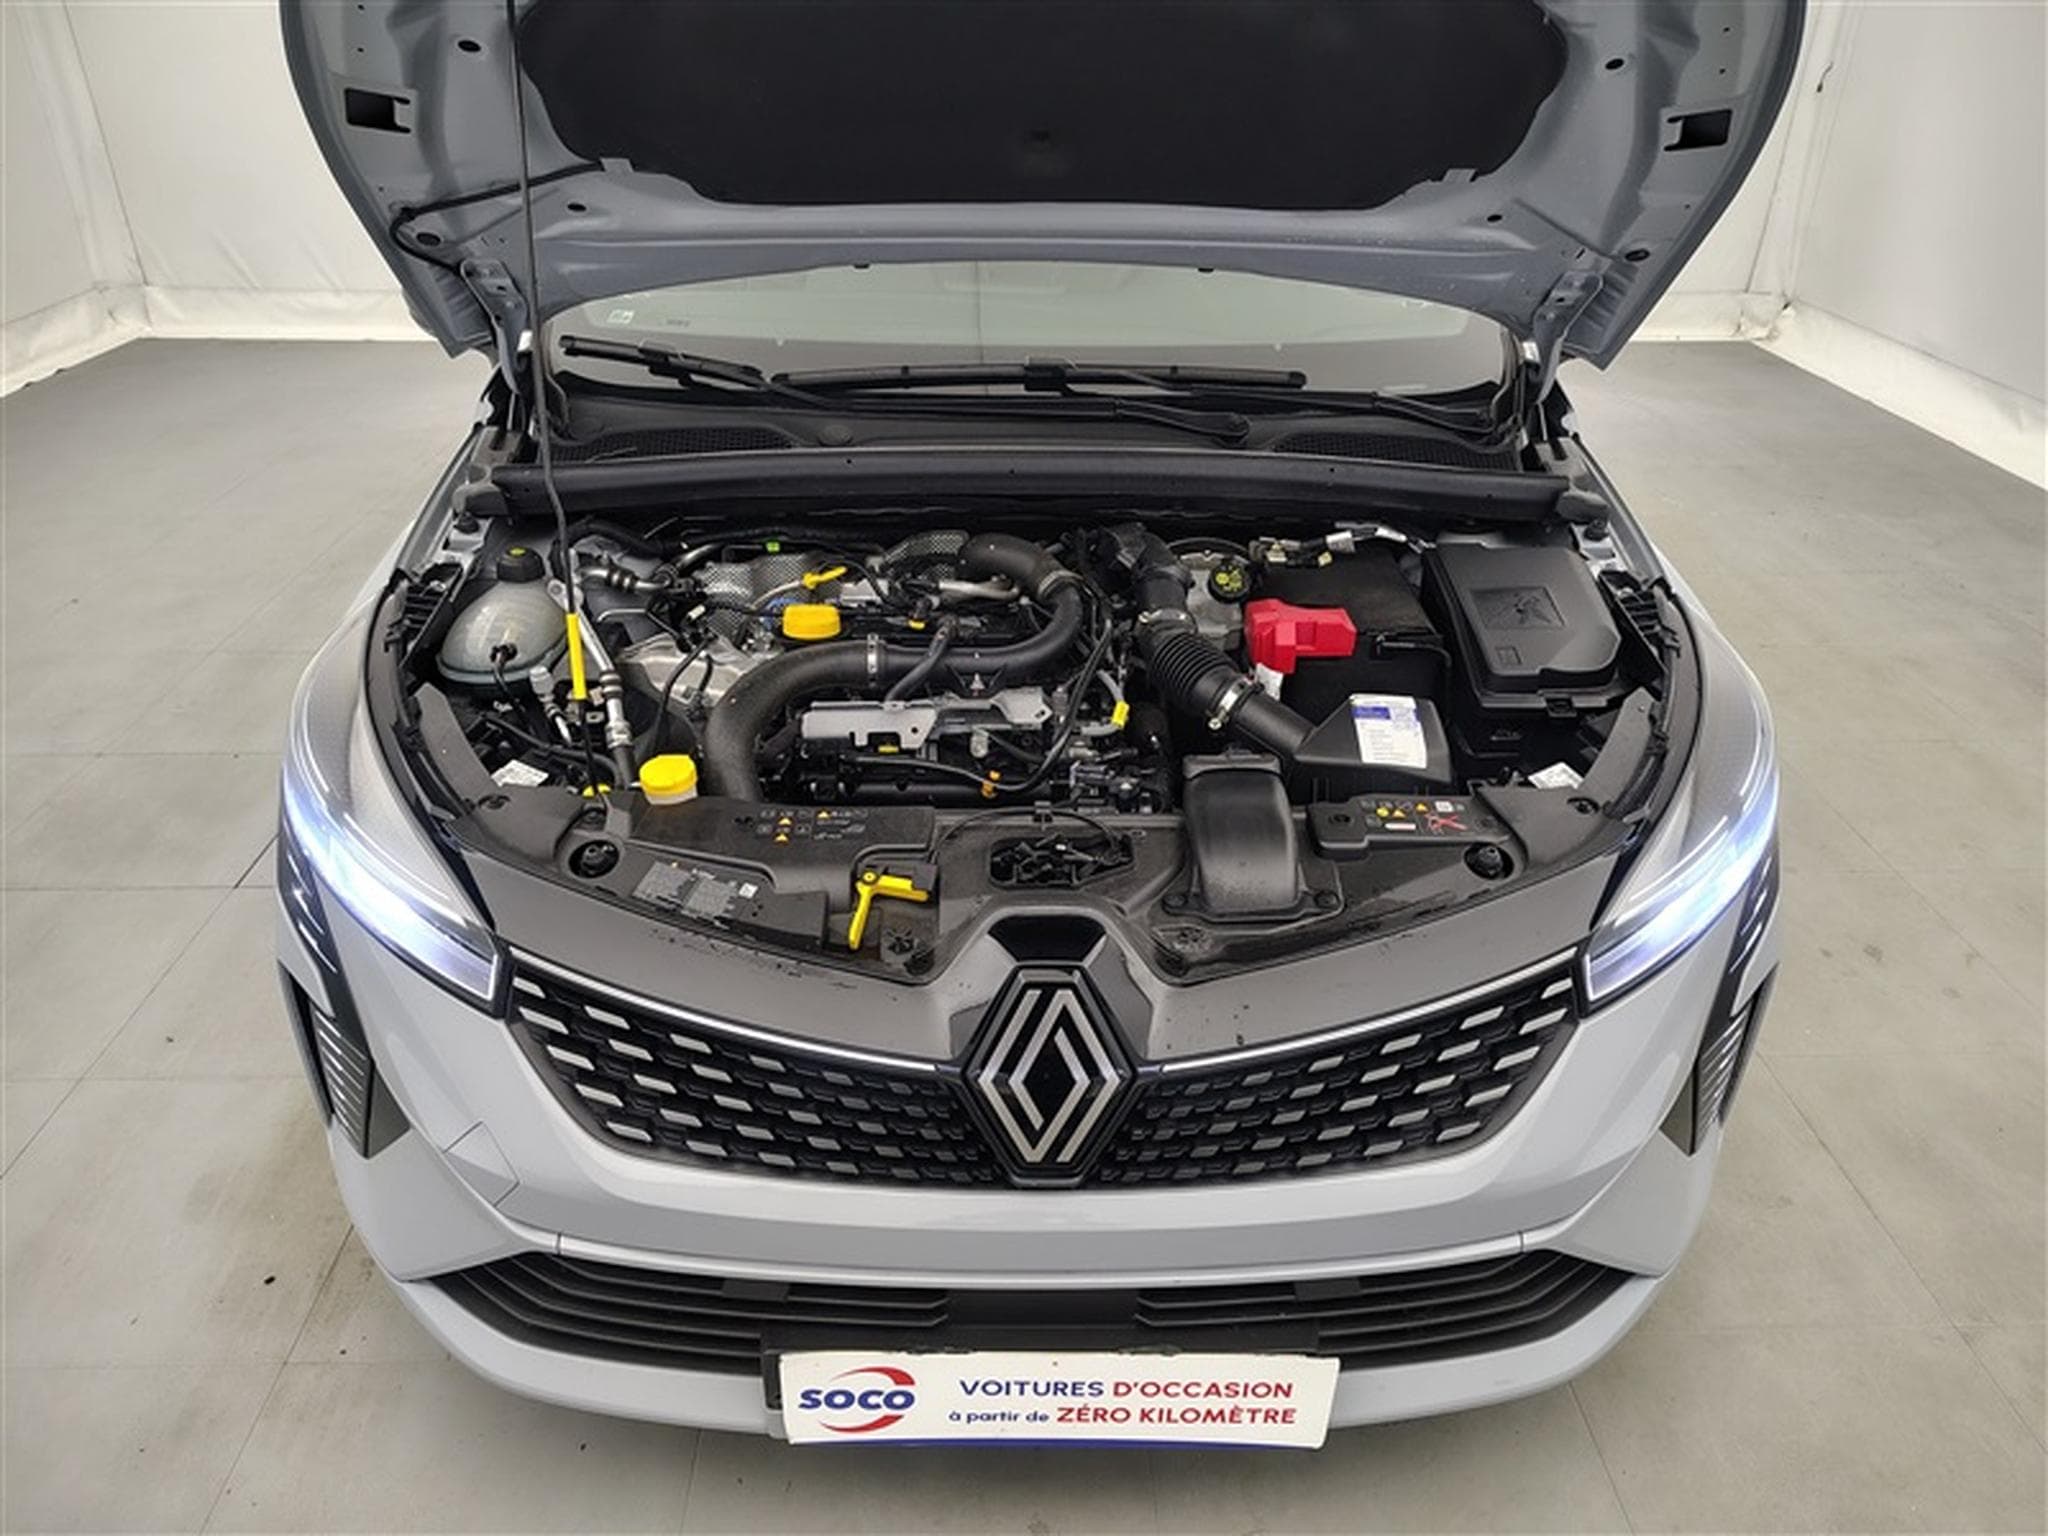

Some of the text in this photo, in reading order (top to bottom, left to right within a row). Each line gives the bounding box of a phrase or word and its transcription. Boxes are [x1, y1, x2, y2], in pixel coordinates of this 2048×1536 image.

[798, 1389, 916, 1411] SOCO
[960, 1379, 1294, 1399] VOITURES D'OCCASION
[948, 1403, 1298, 1425] à partir de ZÉRO KILOMÈTRE
